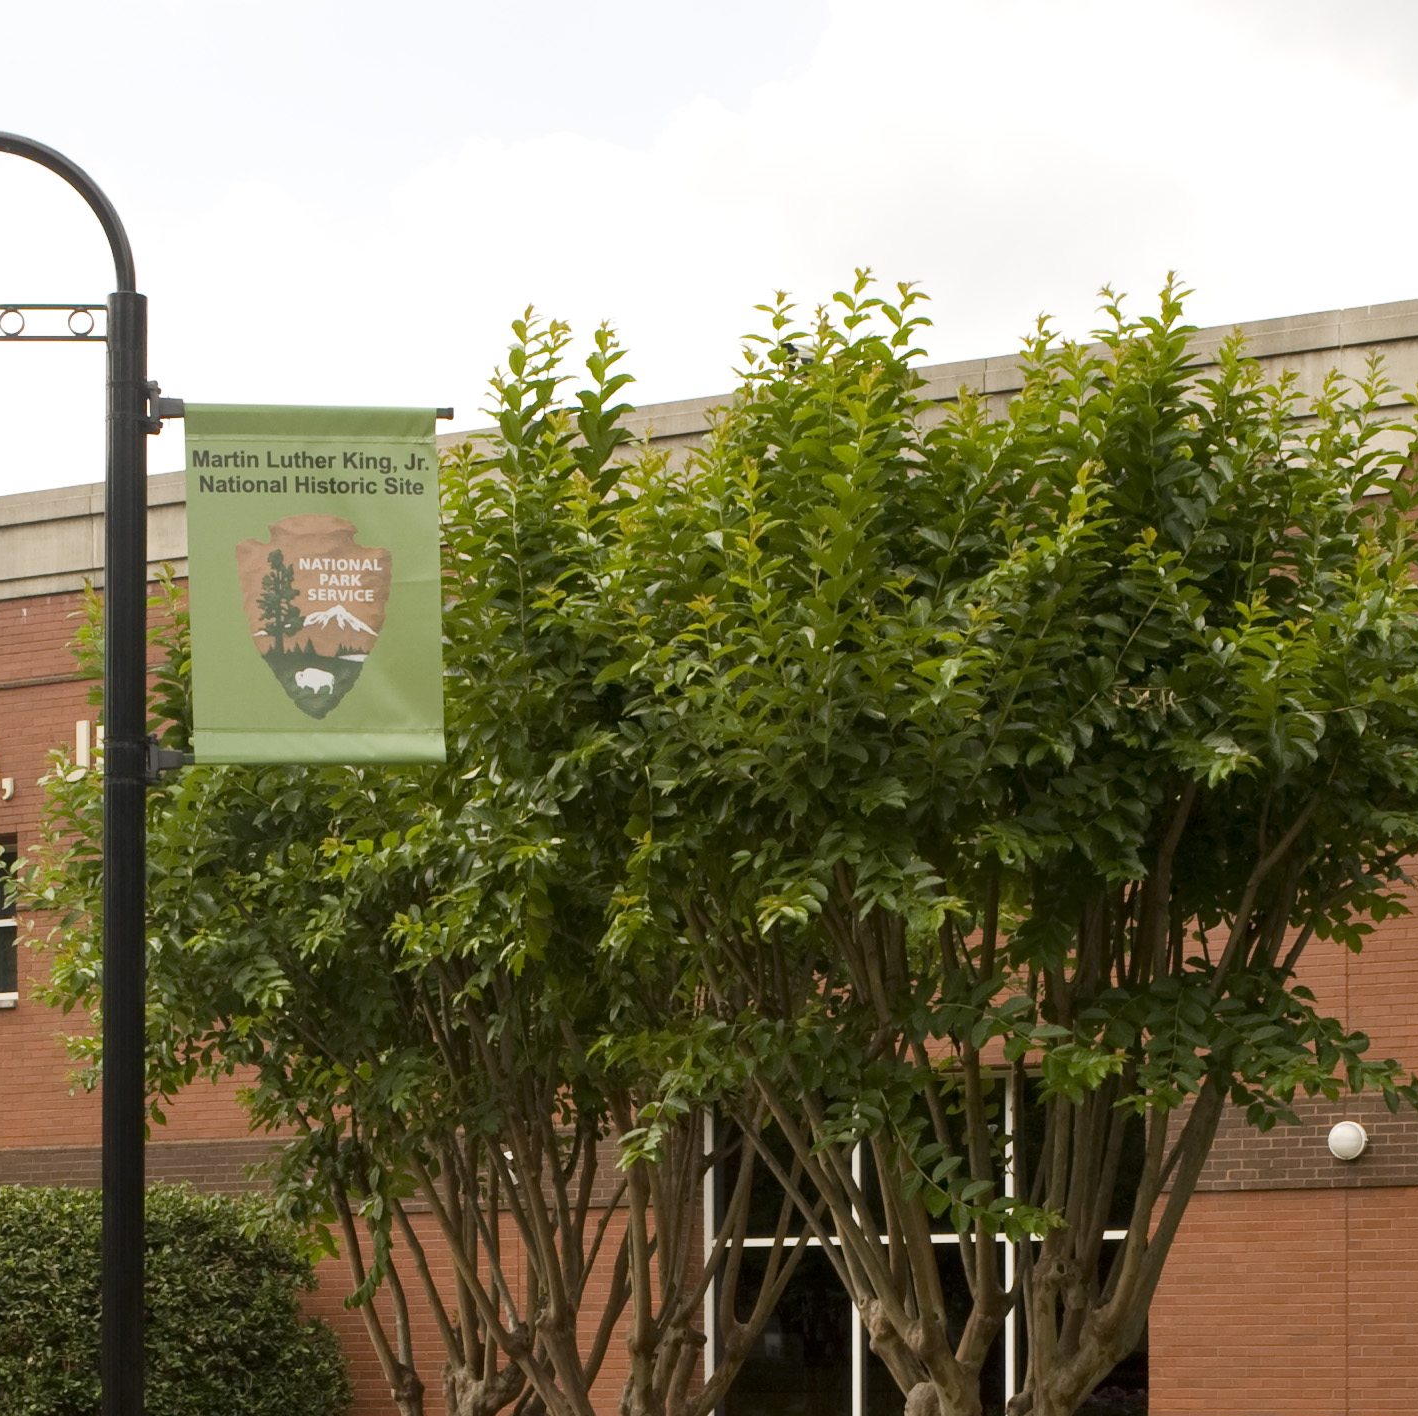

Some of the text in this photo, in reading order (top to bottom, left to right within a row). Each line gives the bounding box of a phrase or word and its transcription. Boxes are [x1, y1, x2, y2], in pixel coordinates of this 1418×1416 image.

[192, 450, 430, 474] Martin Luther King, Jr.
[199, 475, 425, 495] National Historic Site
[298, 557, 382, 572] NATIONAL
[319, 573, 362, 587] PARK
[307, 588, 374, 602] SERVICE
